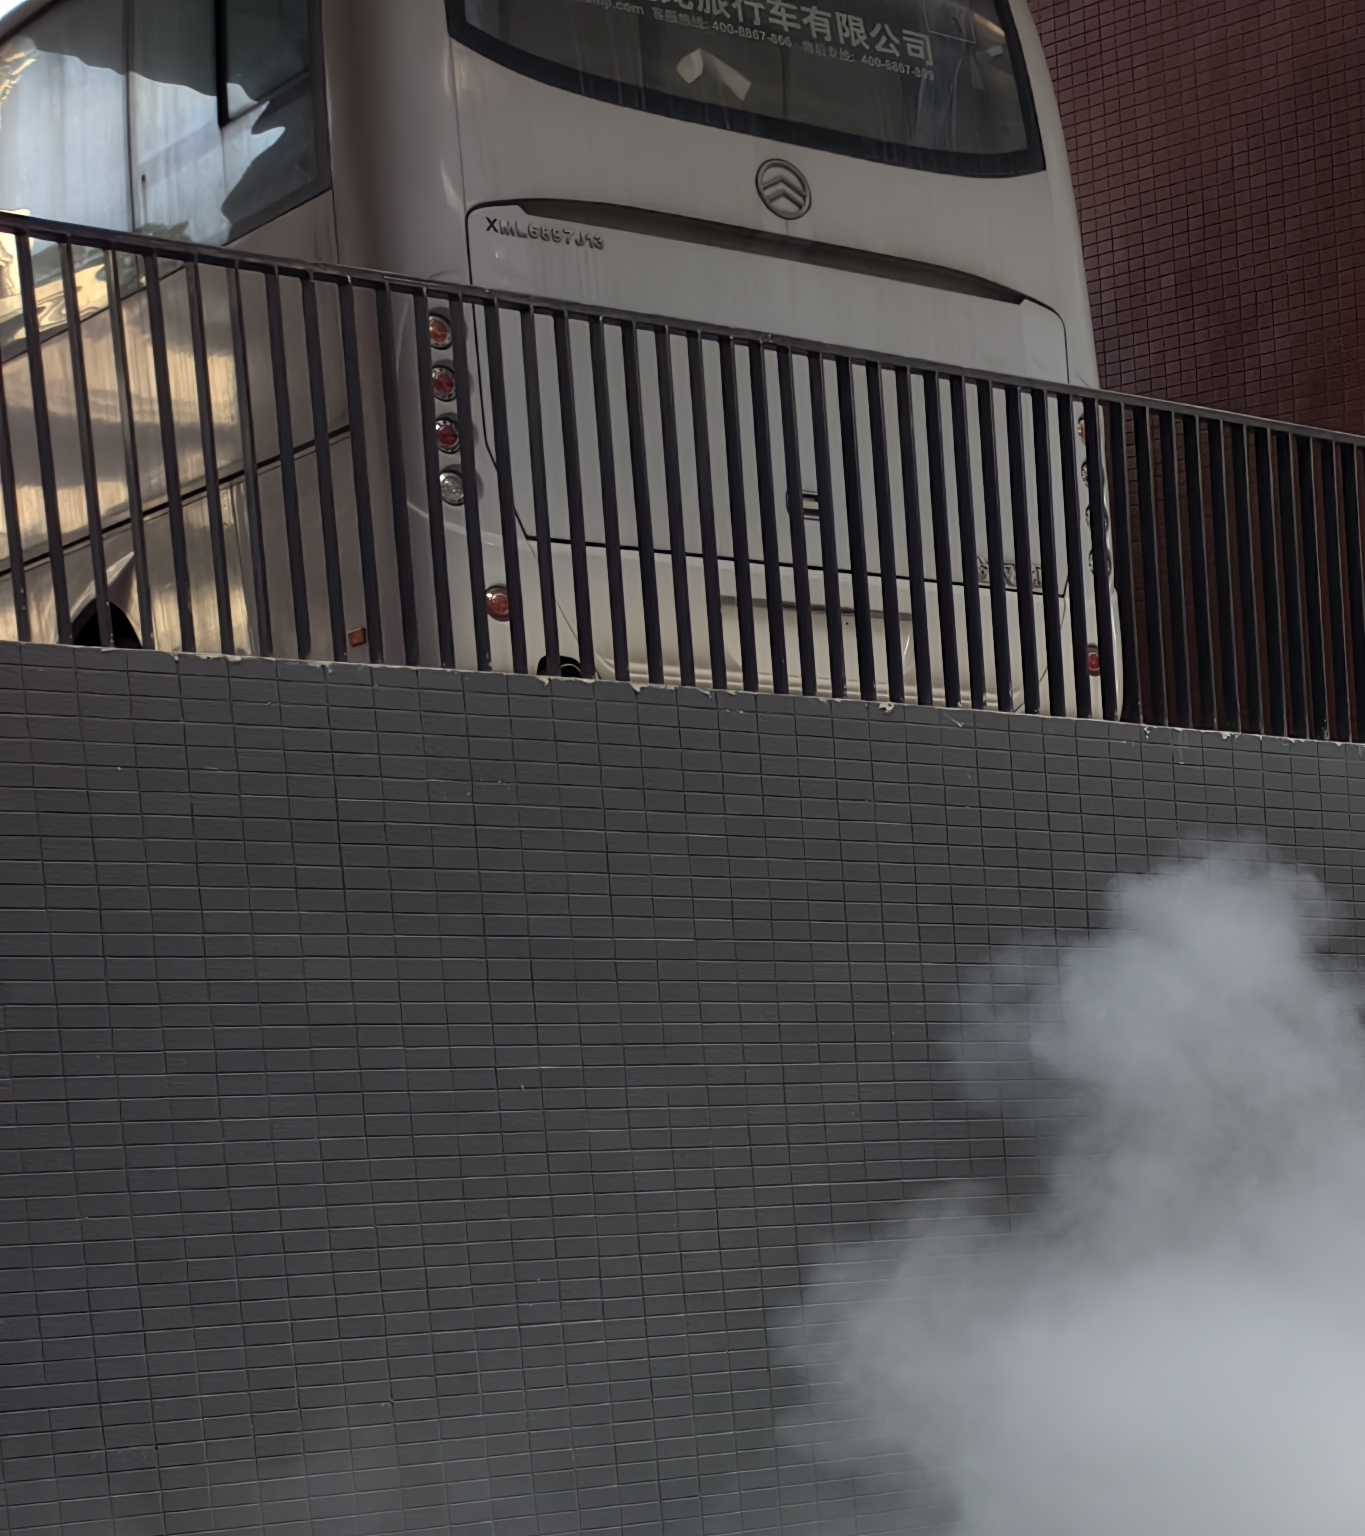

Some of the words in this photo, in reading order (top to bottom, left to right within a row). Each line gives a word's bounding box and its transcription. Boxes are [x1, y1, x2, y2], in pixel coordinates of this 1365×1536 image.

[677, 0, 934, 67] 旅行车有限公司
